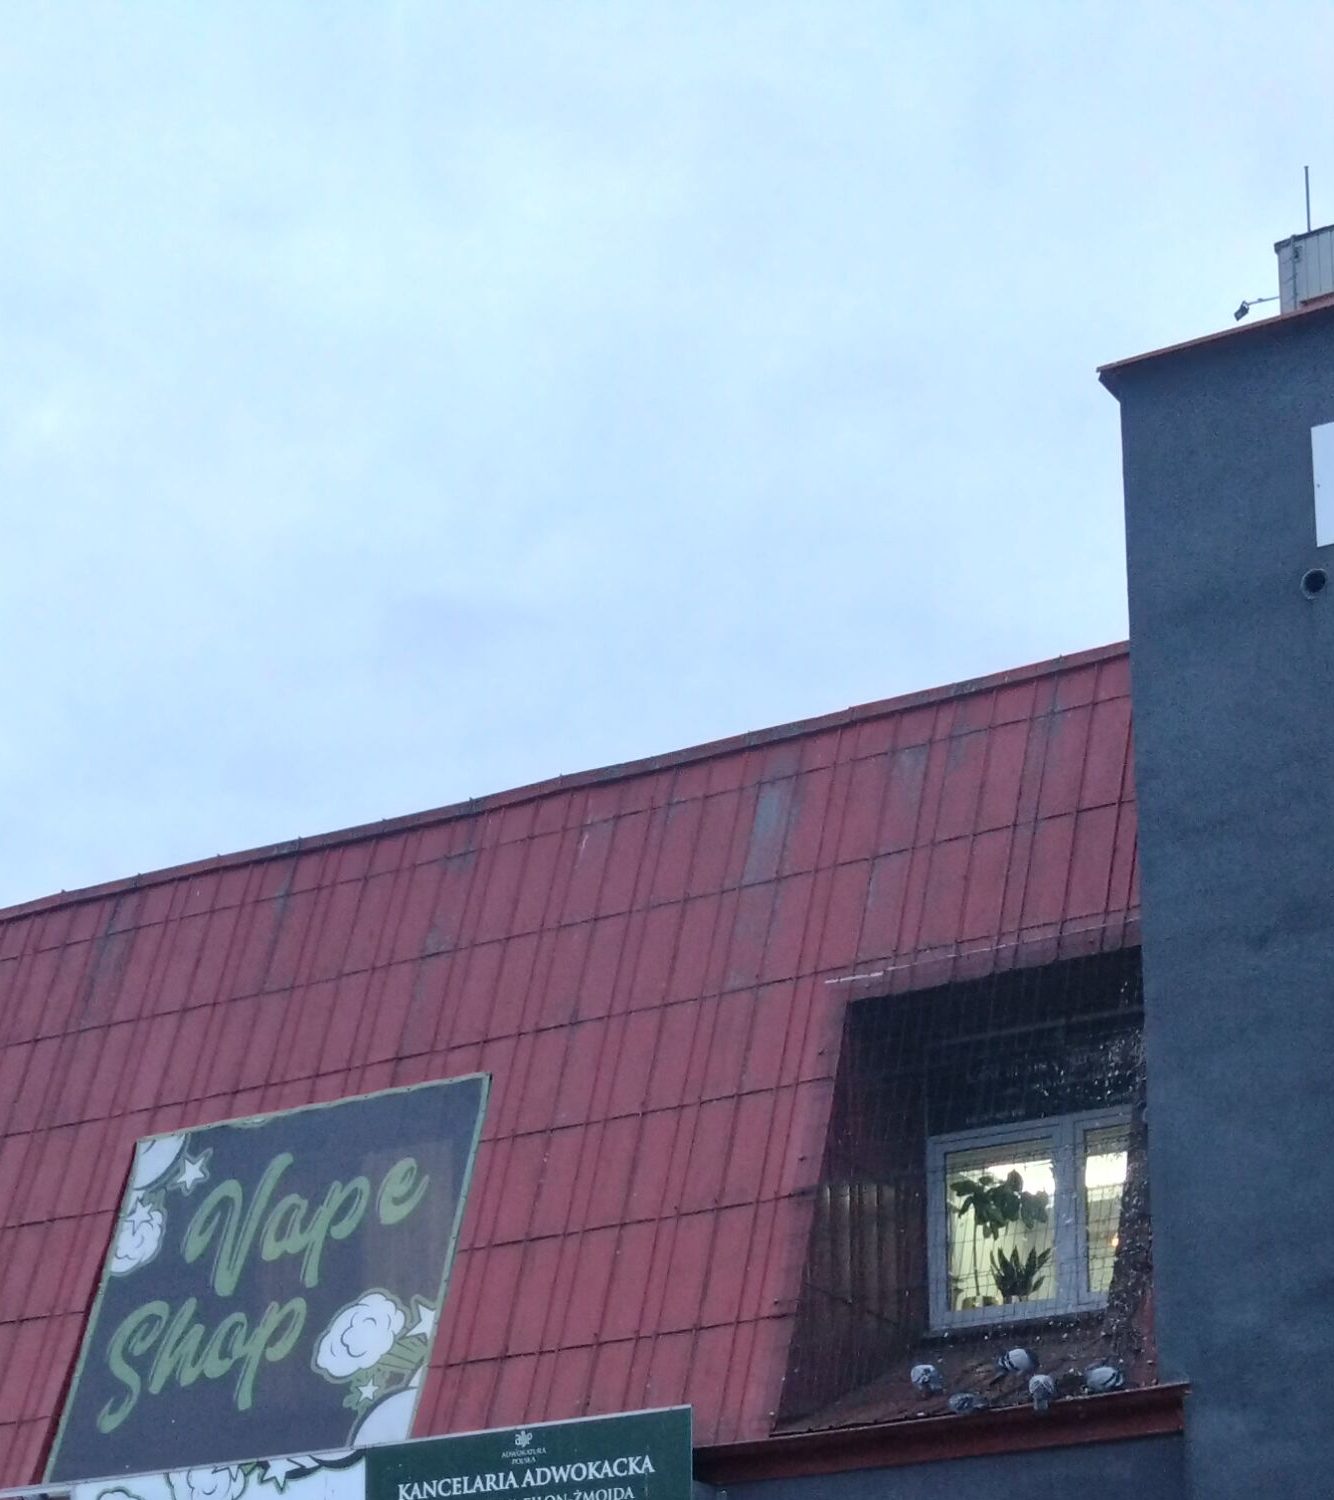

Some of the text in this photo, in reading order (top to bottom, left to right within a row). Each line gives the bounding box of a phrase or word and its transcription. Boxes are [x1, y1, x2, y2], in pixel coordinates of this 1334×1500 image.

[180, 1153, 429, 1297] Vape
[97, 1296, 308, 1434] Shop
[521, 1454, 655, 1488] ADWOKACKA
